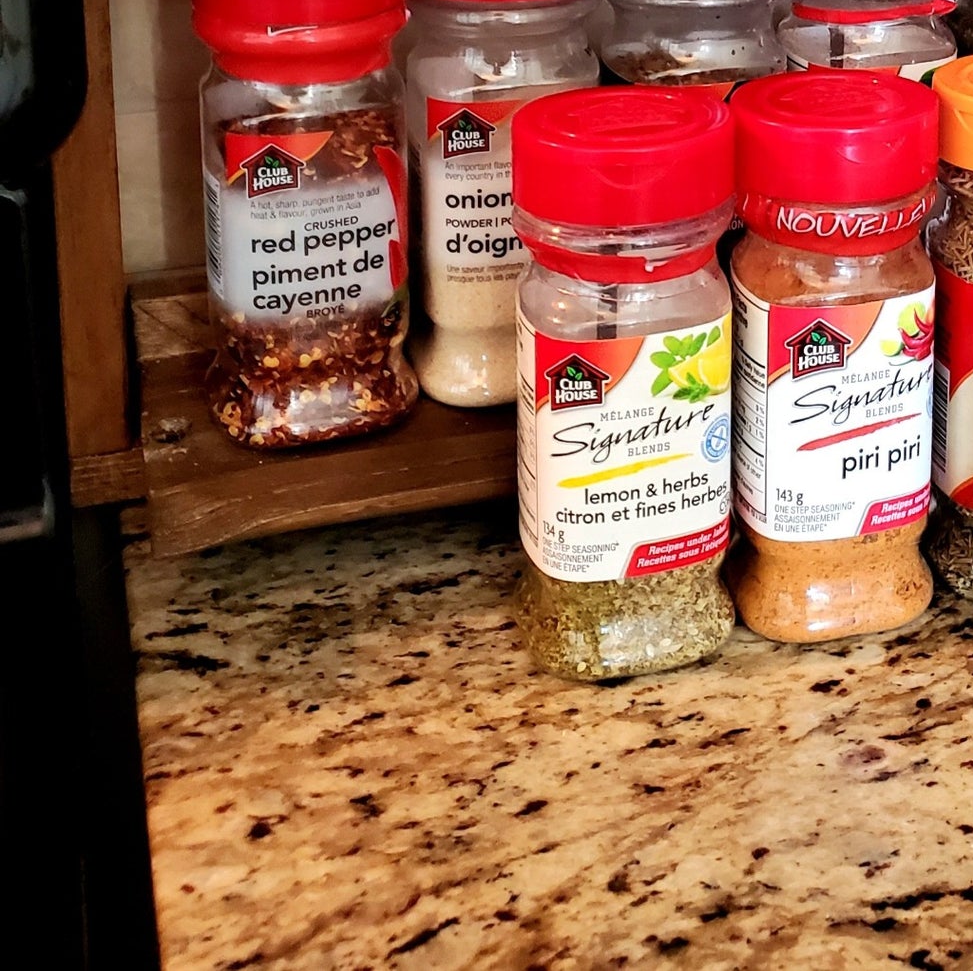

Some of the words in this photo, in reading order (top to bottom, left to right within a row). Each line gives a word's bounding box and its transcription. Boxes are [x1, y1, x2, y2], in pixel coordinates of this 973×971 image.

[452, 130, 480, 140] CLUB
[448, 139, 485, 152] HOUSE
[257, 167, 288, 178] CLUB
[494, 161, 512, 169] flavo
[253, 175, 294, 191] HOUSE
[304, 215, 359, 232] CRUSHED
[445, 217, 493, 228] POWDER
[251, 230, 296, 254] red
[303, 218, 395, 256] pepper
[446, 233, 523, 258] d'oign
[251, 256, 347, 290] piment
[352, 250, 385, 274] de
[253, 283, 362, 315] cayenne
[306, 303, 345, 318] BROYÉ
[803, 344, 835, 356] CLUB
[798, 353, 840, 371] HOUSE
[841, 369, 891, 384] MÉLANGE
[559, 378, 593, 391] CLUB
[555, 388, 598, 404] HOUSE
[790, 363, 932, 424] Signatur
[600, 406, 655, 422] MÉLANGE
[865, 403, 904, 418] BLENDS
[550, 403, 715, 464] Signature
[628, 442, 671, 457] BLENDS
[842, 445, 880, 479] piri
[888, 434, 921, 472] piri
[585, 488, 640, 506] lemon
[646, 483, 658, 498] &
[662, 471, 709, 495] herbs
[556, 507, 605, 525] citron
[612, 506, 629, 521] et
[636, 500, 676, 519] fines
[681, 481, 727, 510] herbes
[775, 488, 793, 503] 143
[796, 492, 804, 506] g
[774, 504, 789, 514] ONE
[791, 505, 809, 514] STEP
[881, 498, 914, 513] Recipes
[774, 512, 841, 524] ASSAISONNEMENT
[870, 511, 907, 526] Recettes
[774, 524, 784, 532] EN
[785, 524, 800, 533] UNE
[558, 530, 565, 543] g
[554, 542, 570, 551] STEP
[648, 541, 685, 556] Recipes
[687, 533, 713, 547] under
[636, 553, 677, 569] Recettes
[678, 547, 700, 560] sous
